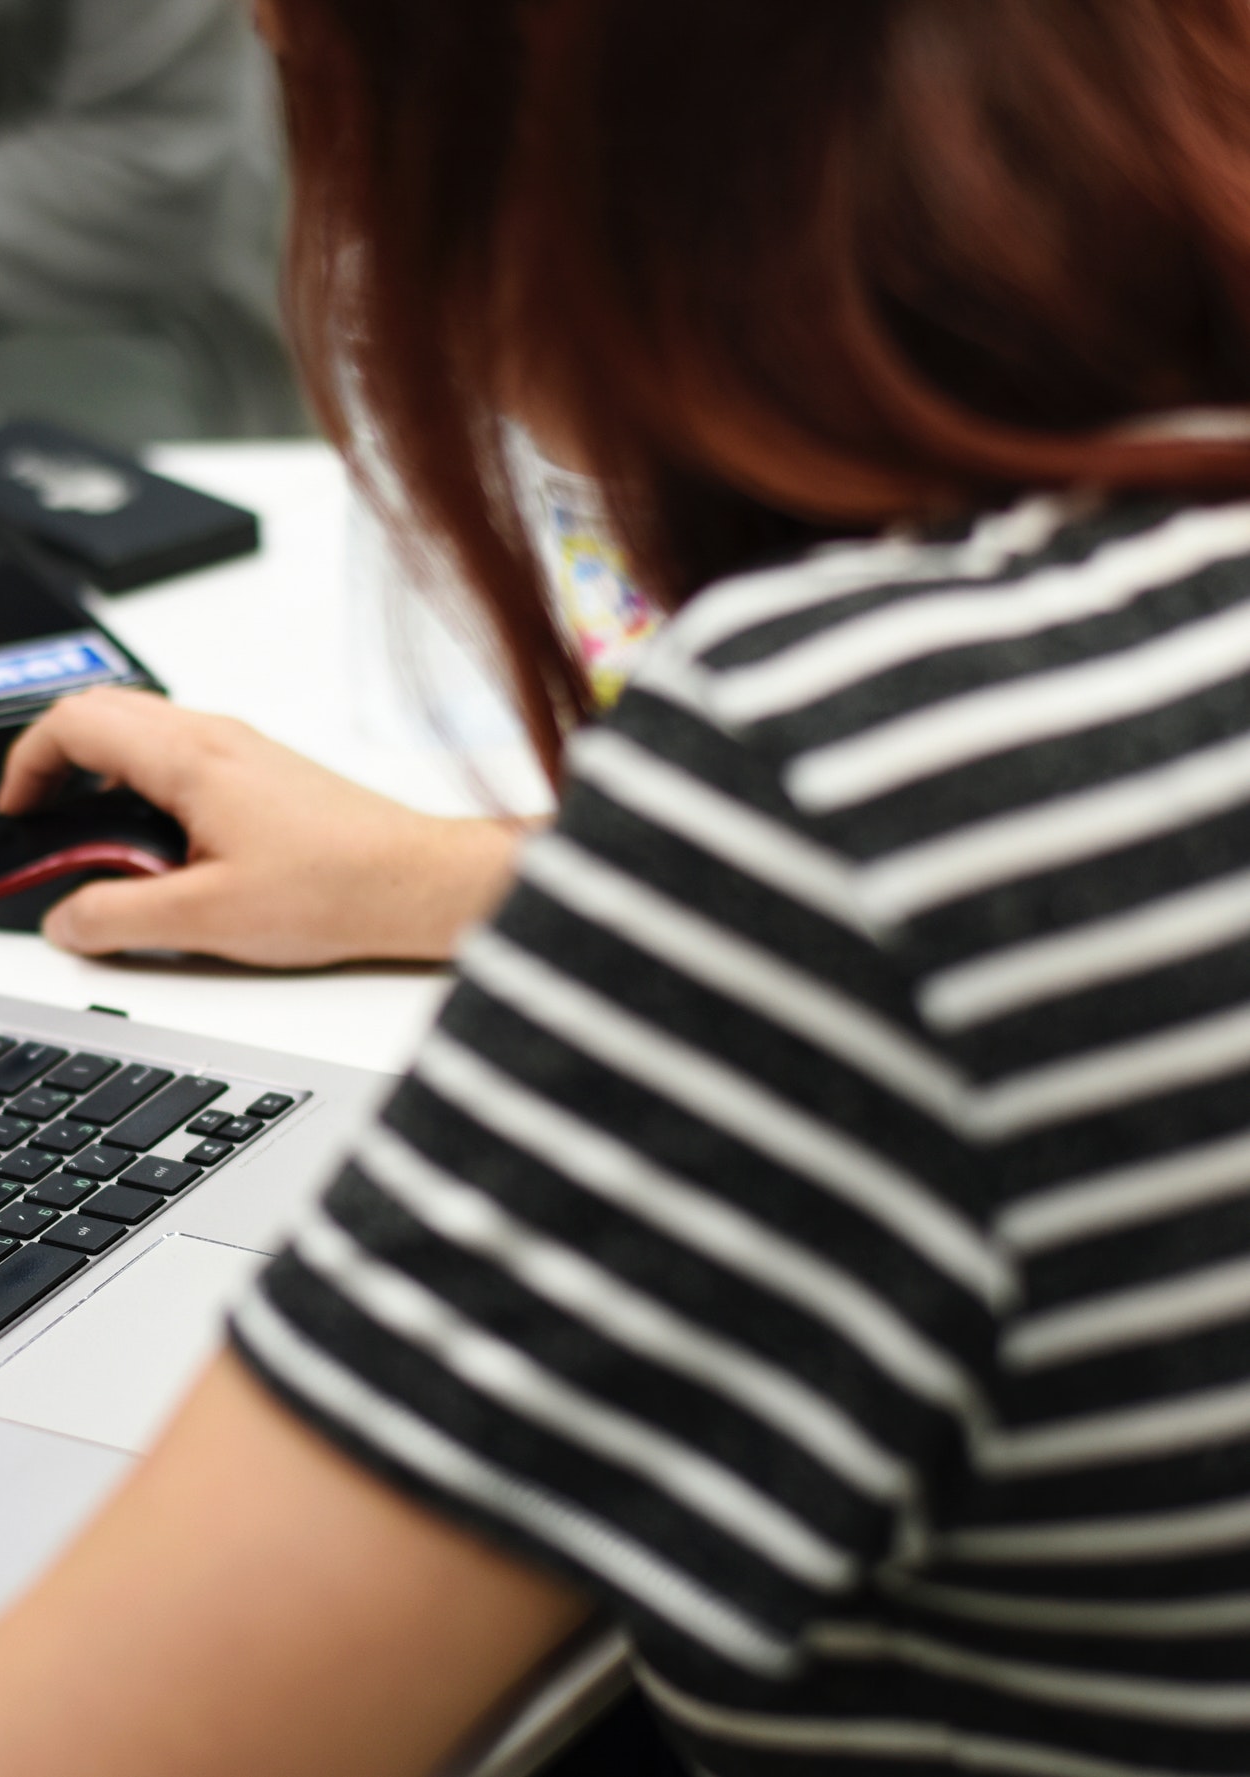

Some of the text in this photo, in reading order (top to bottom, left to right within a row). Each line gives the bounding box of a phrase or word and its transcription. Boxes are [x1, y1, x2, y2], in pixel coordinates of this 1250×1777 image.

[155, 1167, 168, 1177] ctrl
[2, 1183, 18, 1191] Д
[73, 1180, 90, 1188] Ю
[78, 1226, 90, 1236] alt
